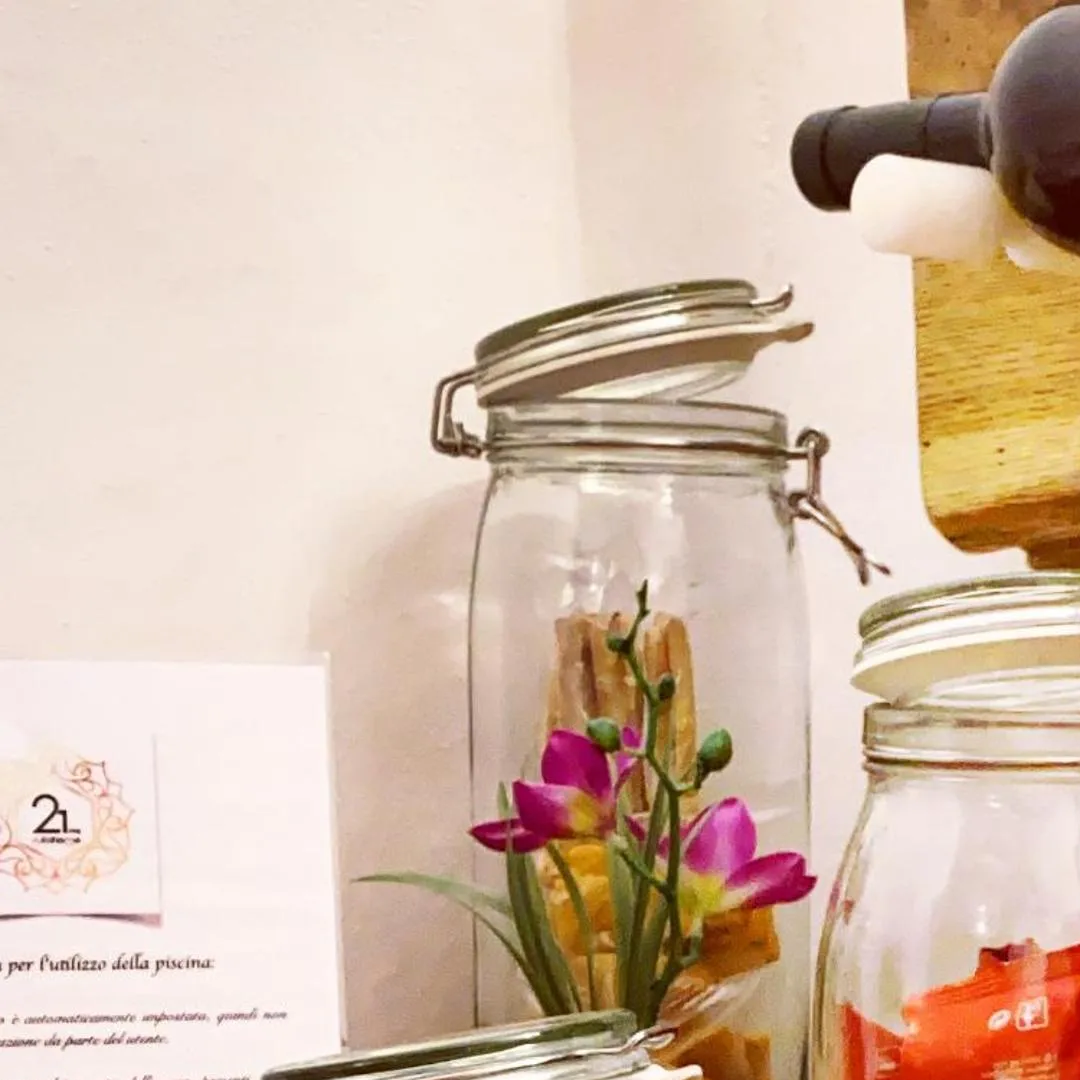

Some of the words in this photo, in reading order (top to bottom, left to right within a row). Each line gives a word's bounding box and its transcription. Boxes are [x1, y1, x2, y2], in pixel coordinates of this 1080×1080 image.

[4, 961, 34, 980] per
[40, 952, 107, 972] l'utilizzo
[111, 952, 149, 971] della
[60, 1035, 100, 1051] parte
